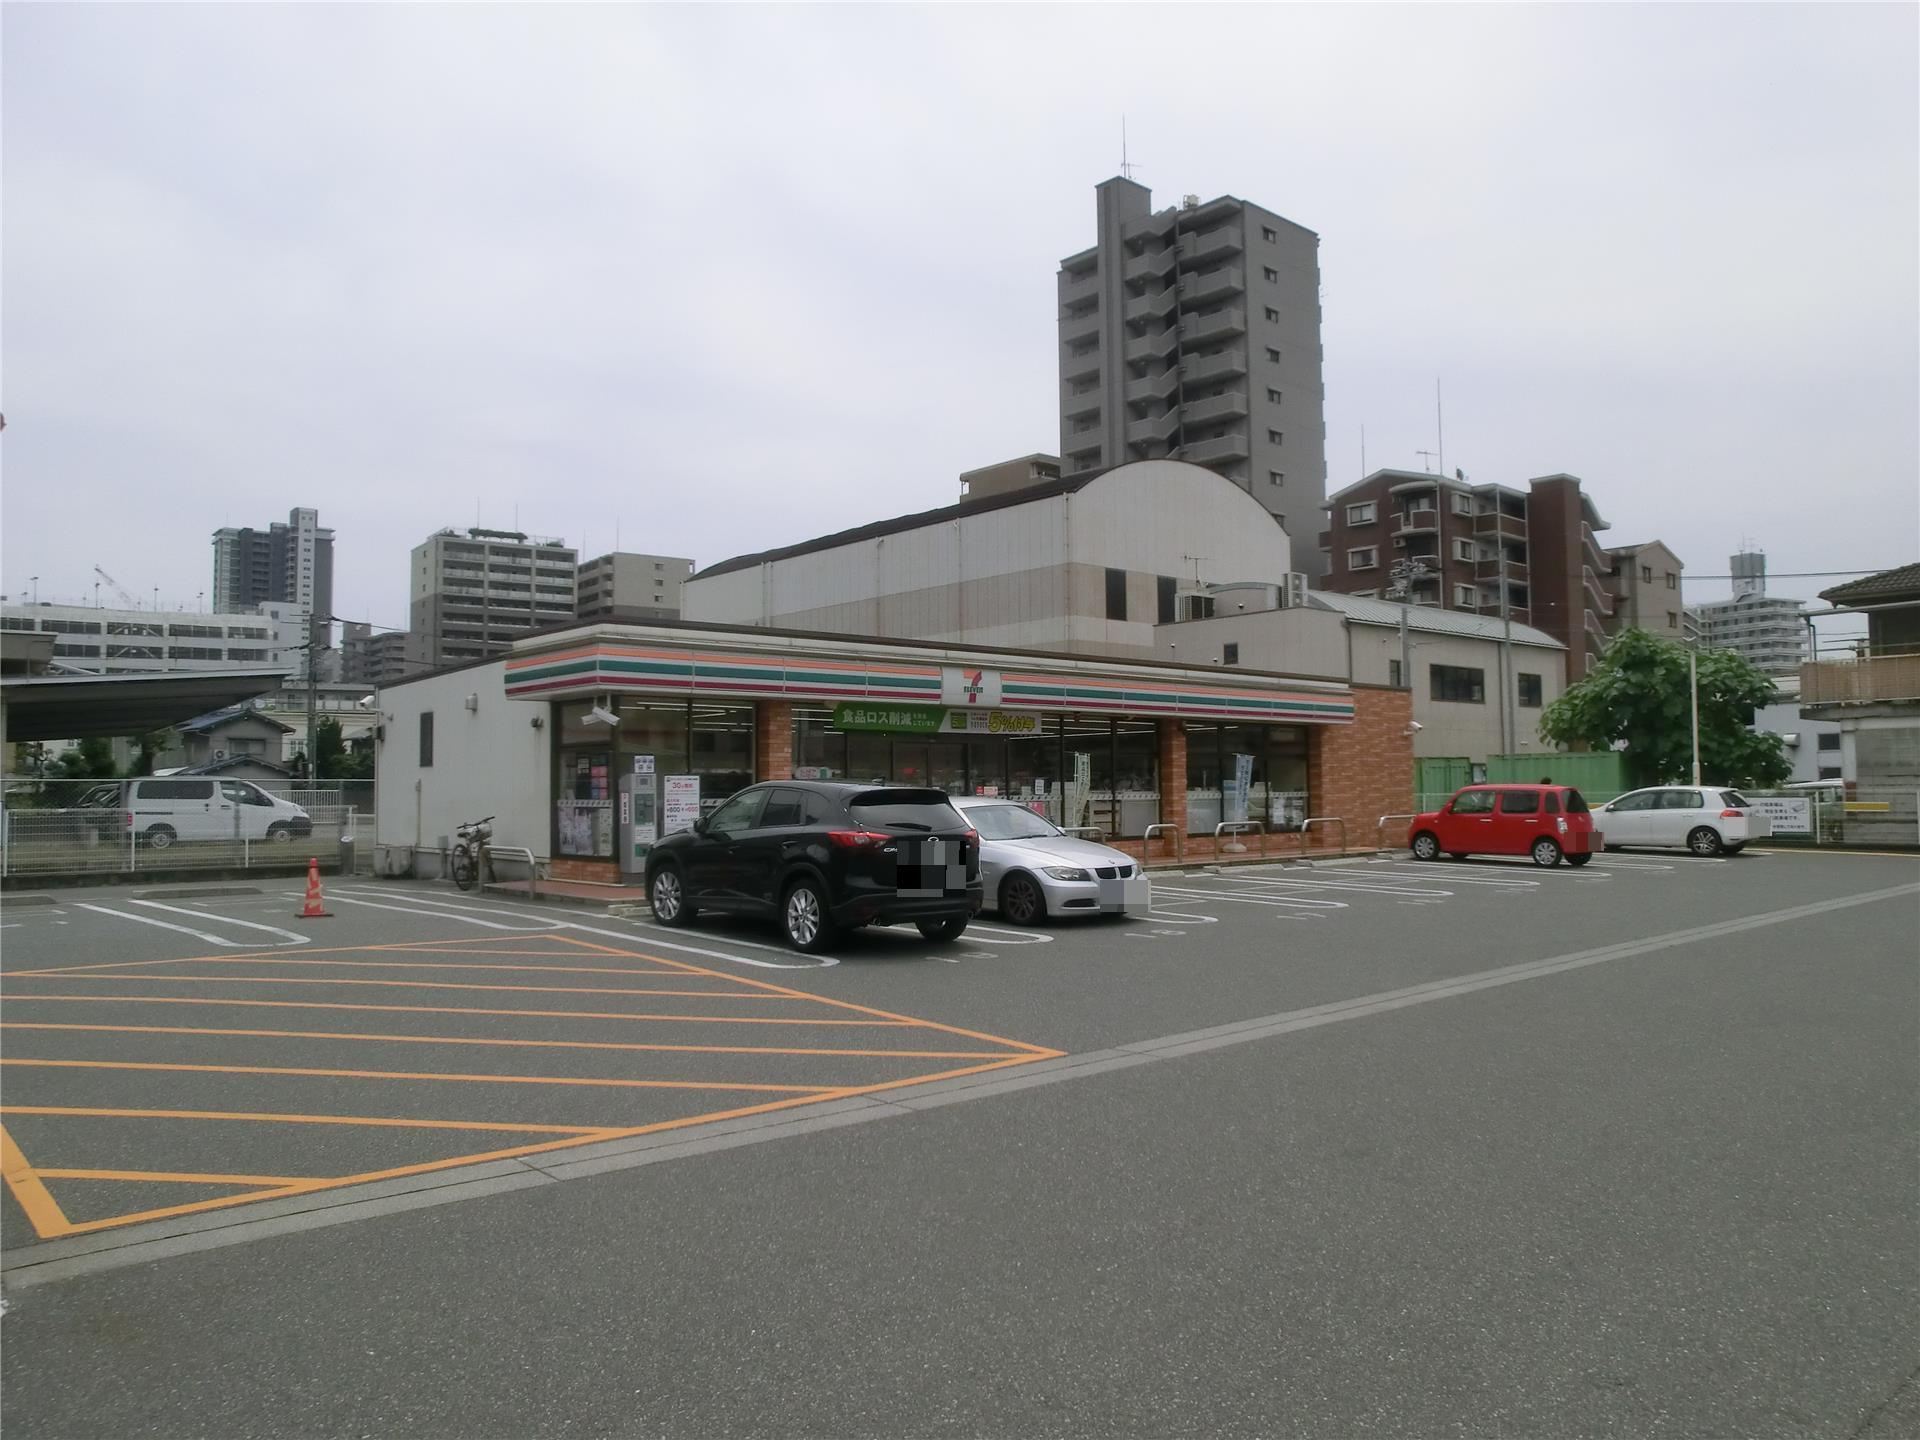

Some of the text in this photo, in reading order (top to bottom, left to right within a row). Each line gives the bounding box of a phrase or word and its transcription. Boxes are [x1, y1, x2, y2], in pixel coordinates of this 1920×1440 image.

[842, 709, 912, 725] 食品ロス削減
